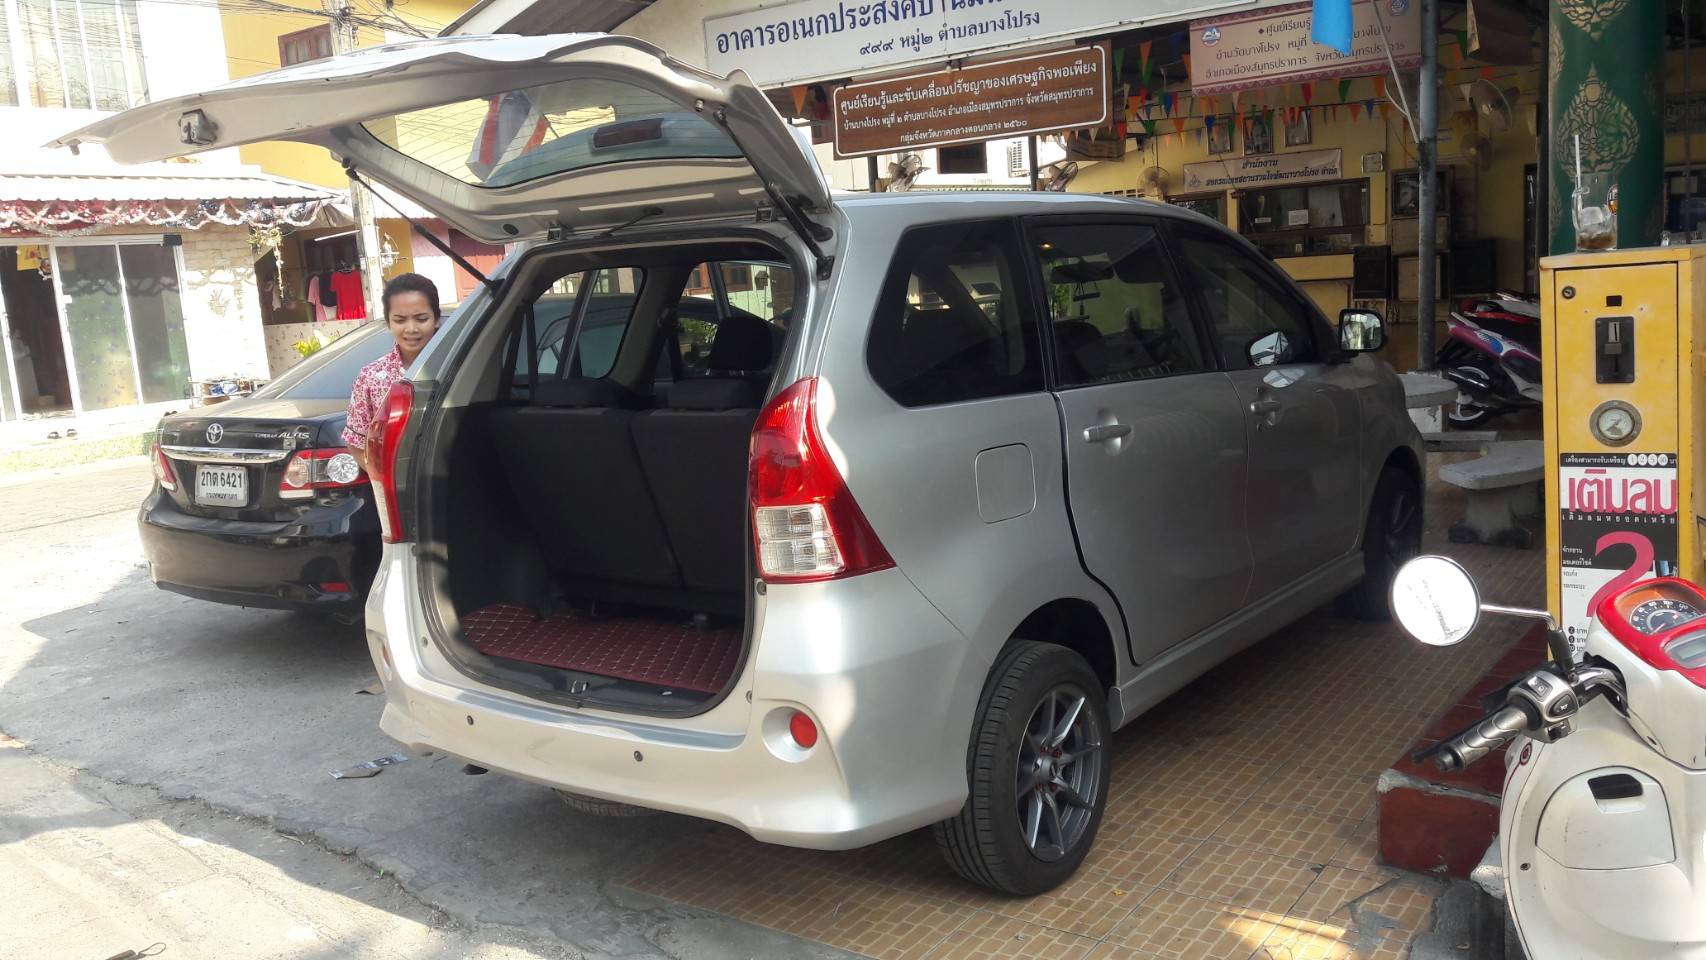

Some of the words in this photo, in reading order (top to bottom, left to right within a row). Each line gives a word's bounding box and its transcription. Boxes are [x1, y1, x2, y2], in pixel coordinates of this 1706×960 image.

[938, 10, 1040, 42] ตำบลบางโปรง
[220, 472, 242, 488] 6421
